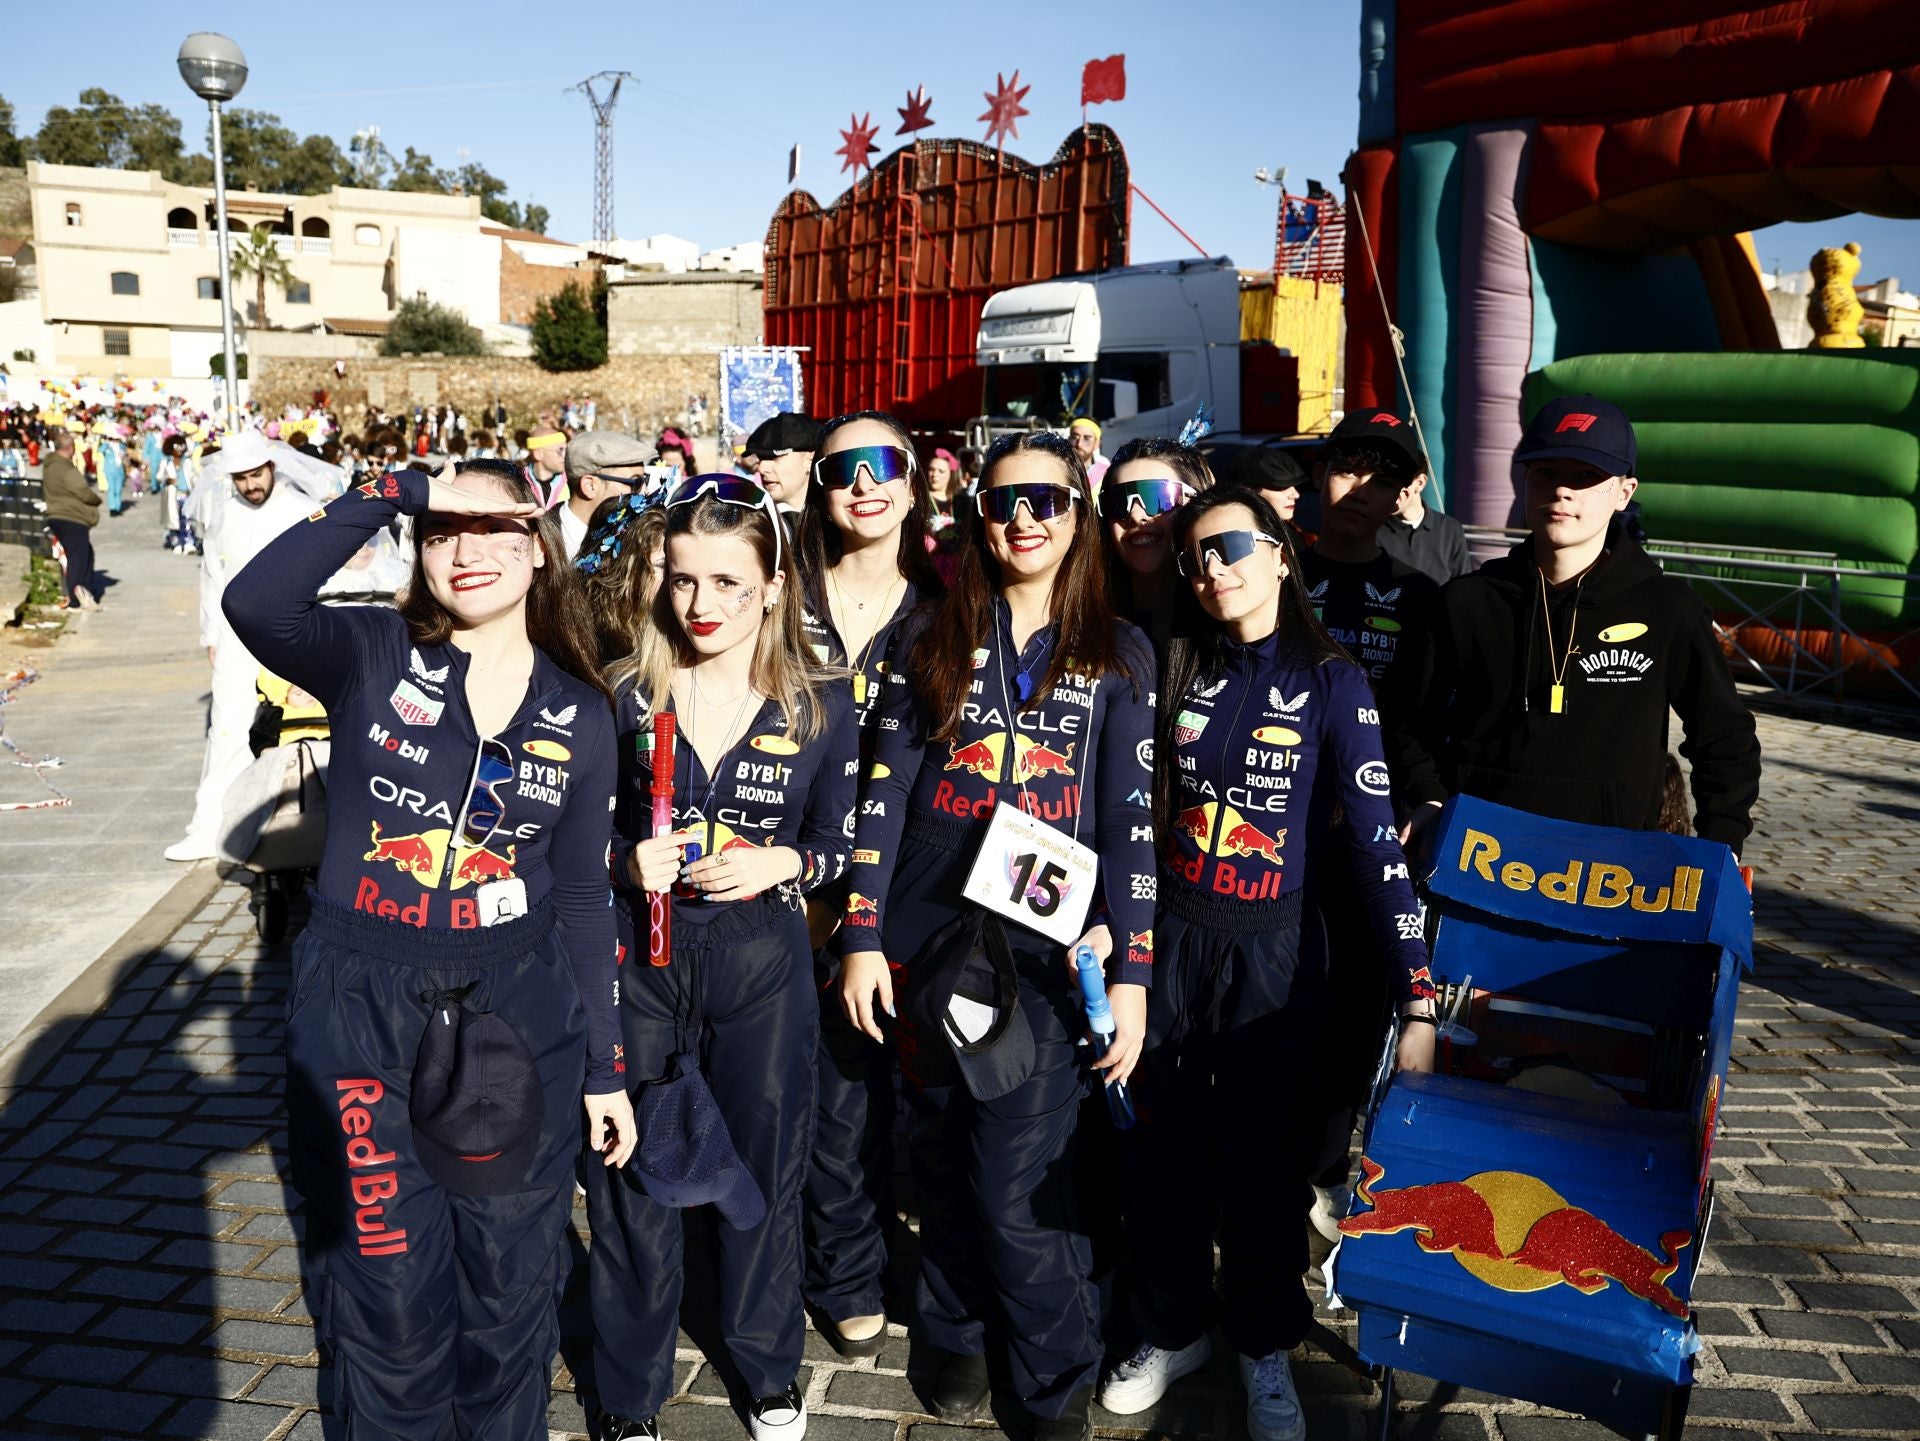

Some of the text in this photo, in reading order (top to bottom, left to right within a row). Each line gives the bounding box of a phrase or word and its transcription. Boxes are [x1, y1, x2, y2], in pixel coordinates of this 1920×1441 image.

[1361, 631, 1397, 651] BYBIT
[1579, 649, 1654, 674] HOODRICH
[393, 694, 436, 724] HEUER
[1262, 712, 1301, 722] CASTORE
[533, 721, 573, 737] CASTORE
[368, 723, 430, 765] Mobil
[1245, 747, 1302, 772] BYBIT
[519, 760, 570, 791] BYBIT
[735, 761, 793, 786] BYBIT
[1245, 773, 1292, 790] HONDA
[517, 781, 562, 807] HONDA
[735, 785, 785, 804] HONDA
[932, 779, 996, 820] Red
[1017, 784, 1083, 821] Bull
[1009, 852, 1068, 918] 15
[1212, 861, 1282, 901] Bull
[354, 876, 430, 928] Red
